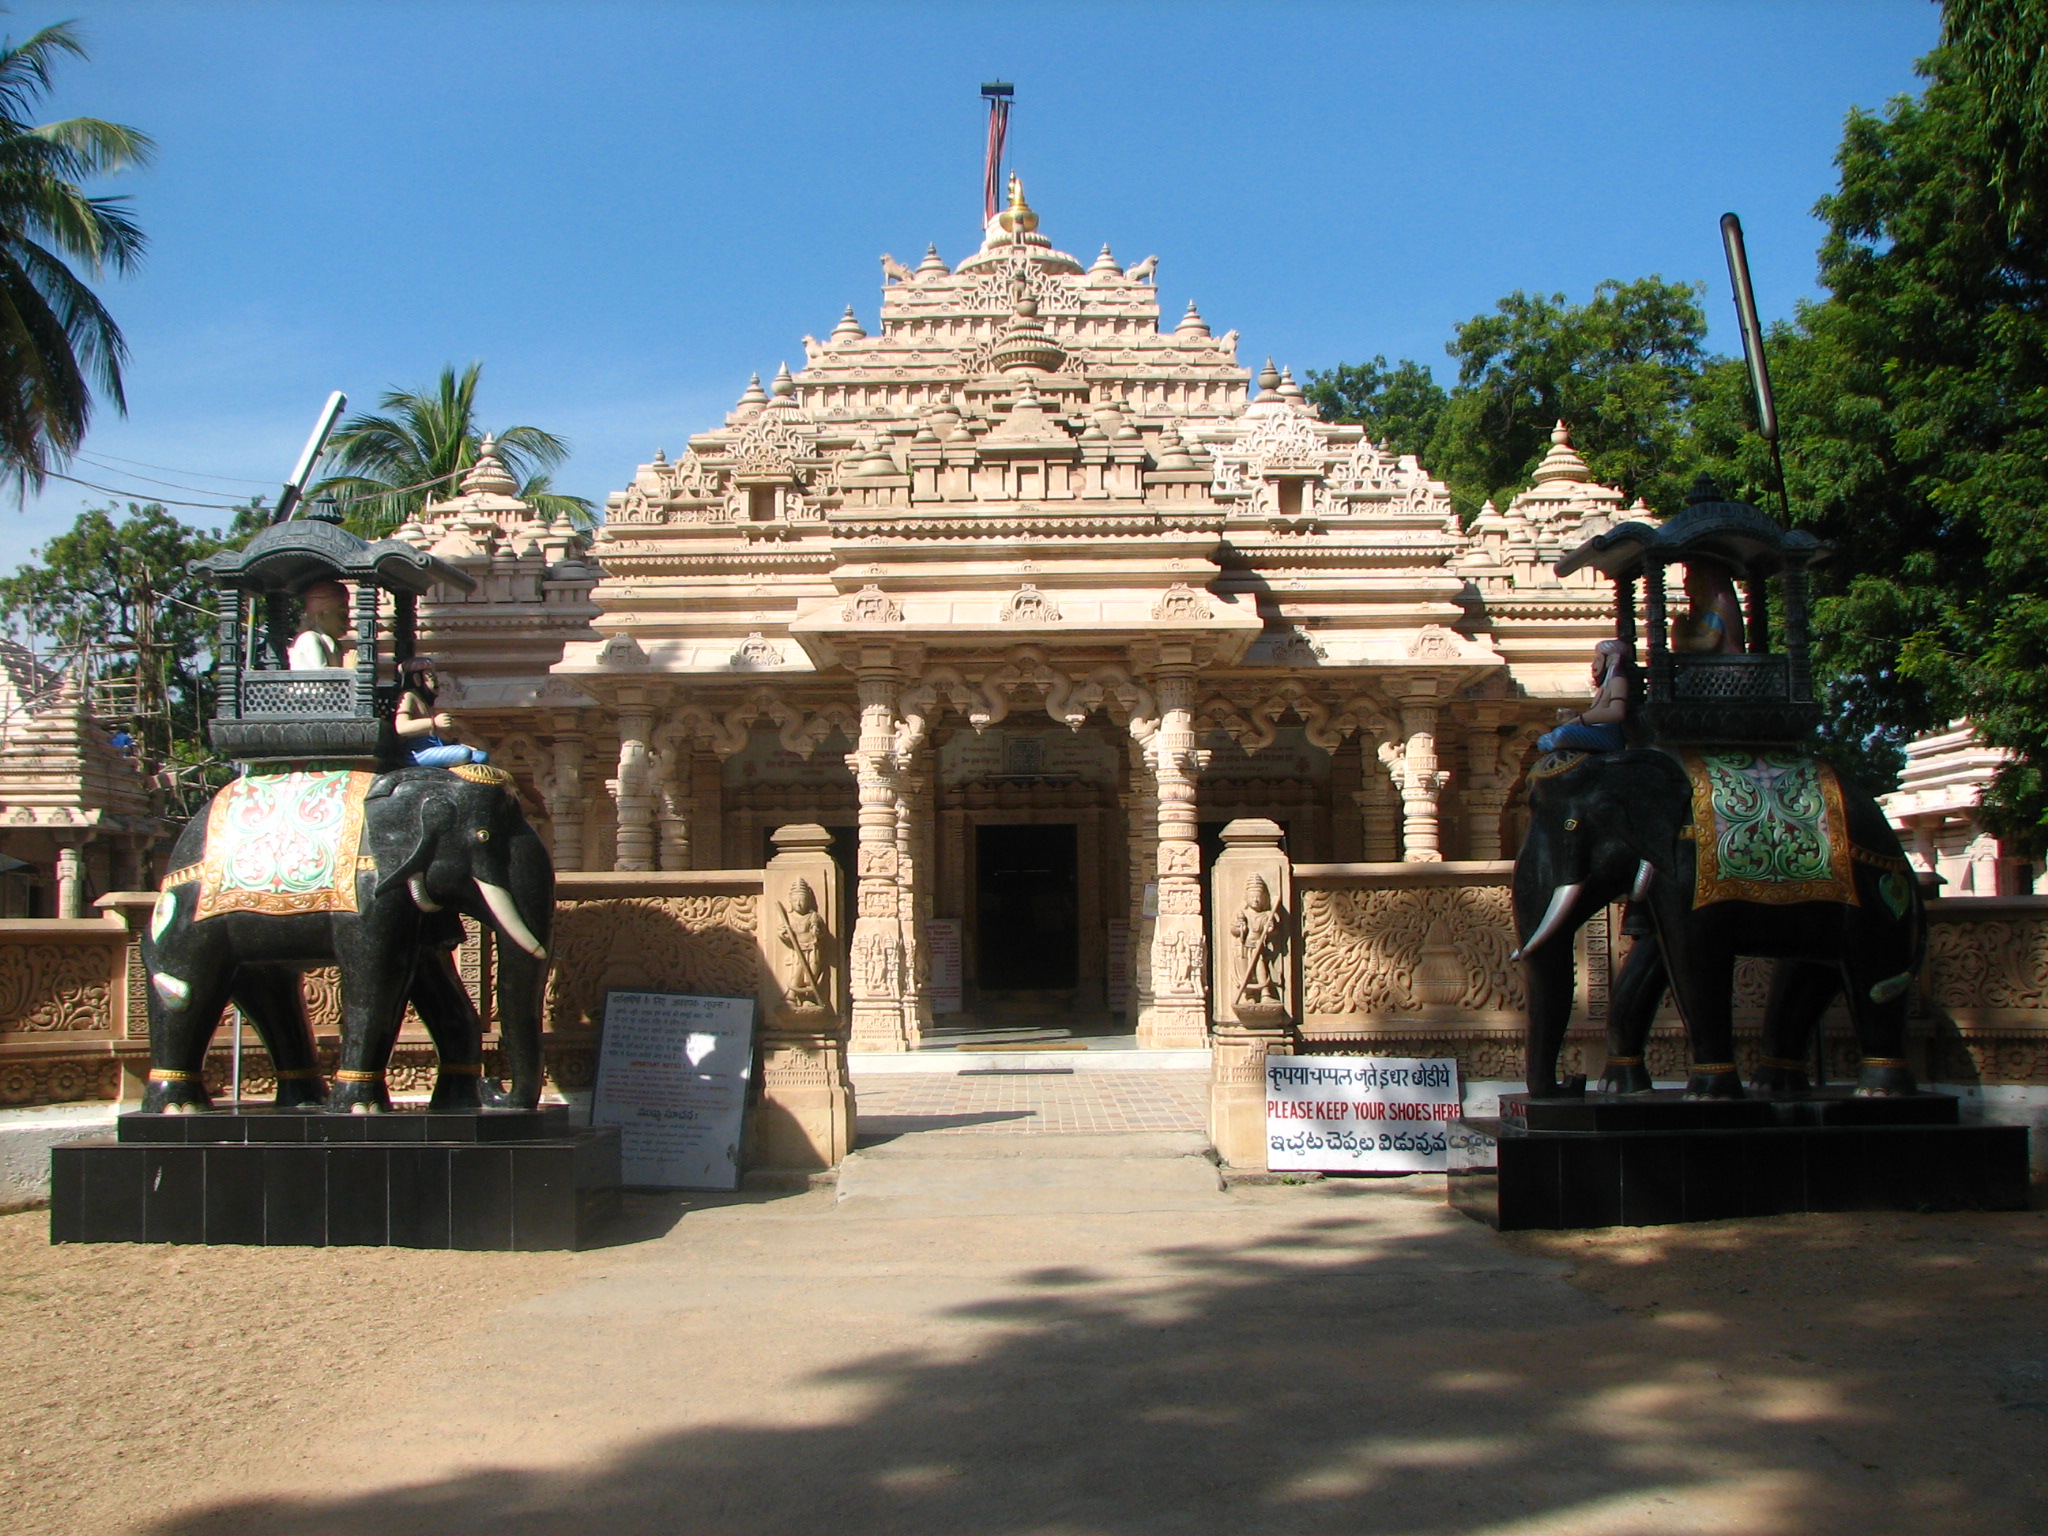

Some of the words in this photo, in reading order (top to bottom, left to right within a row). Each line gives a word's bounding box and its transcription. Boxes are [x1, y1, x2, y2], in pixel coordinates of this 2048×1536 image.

[1268, 1067, 1310, 1091] कृपया
[1310, 1067, 1352, 1086] चप्पल
[1378, 1068, 1409, 1089] इधर
[1268, 1101, 1314, 1120] PLEASE
[1316, 1101, 1349, 1120] KEEP
[1352, 1102, 1386, 1120] YOUR
[1389, 1102, 1431, 1121] SHOES
[1270, 1131, 1323, 1156] ఇచ్చట
